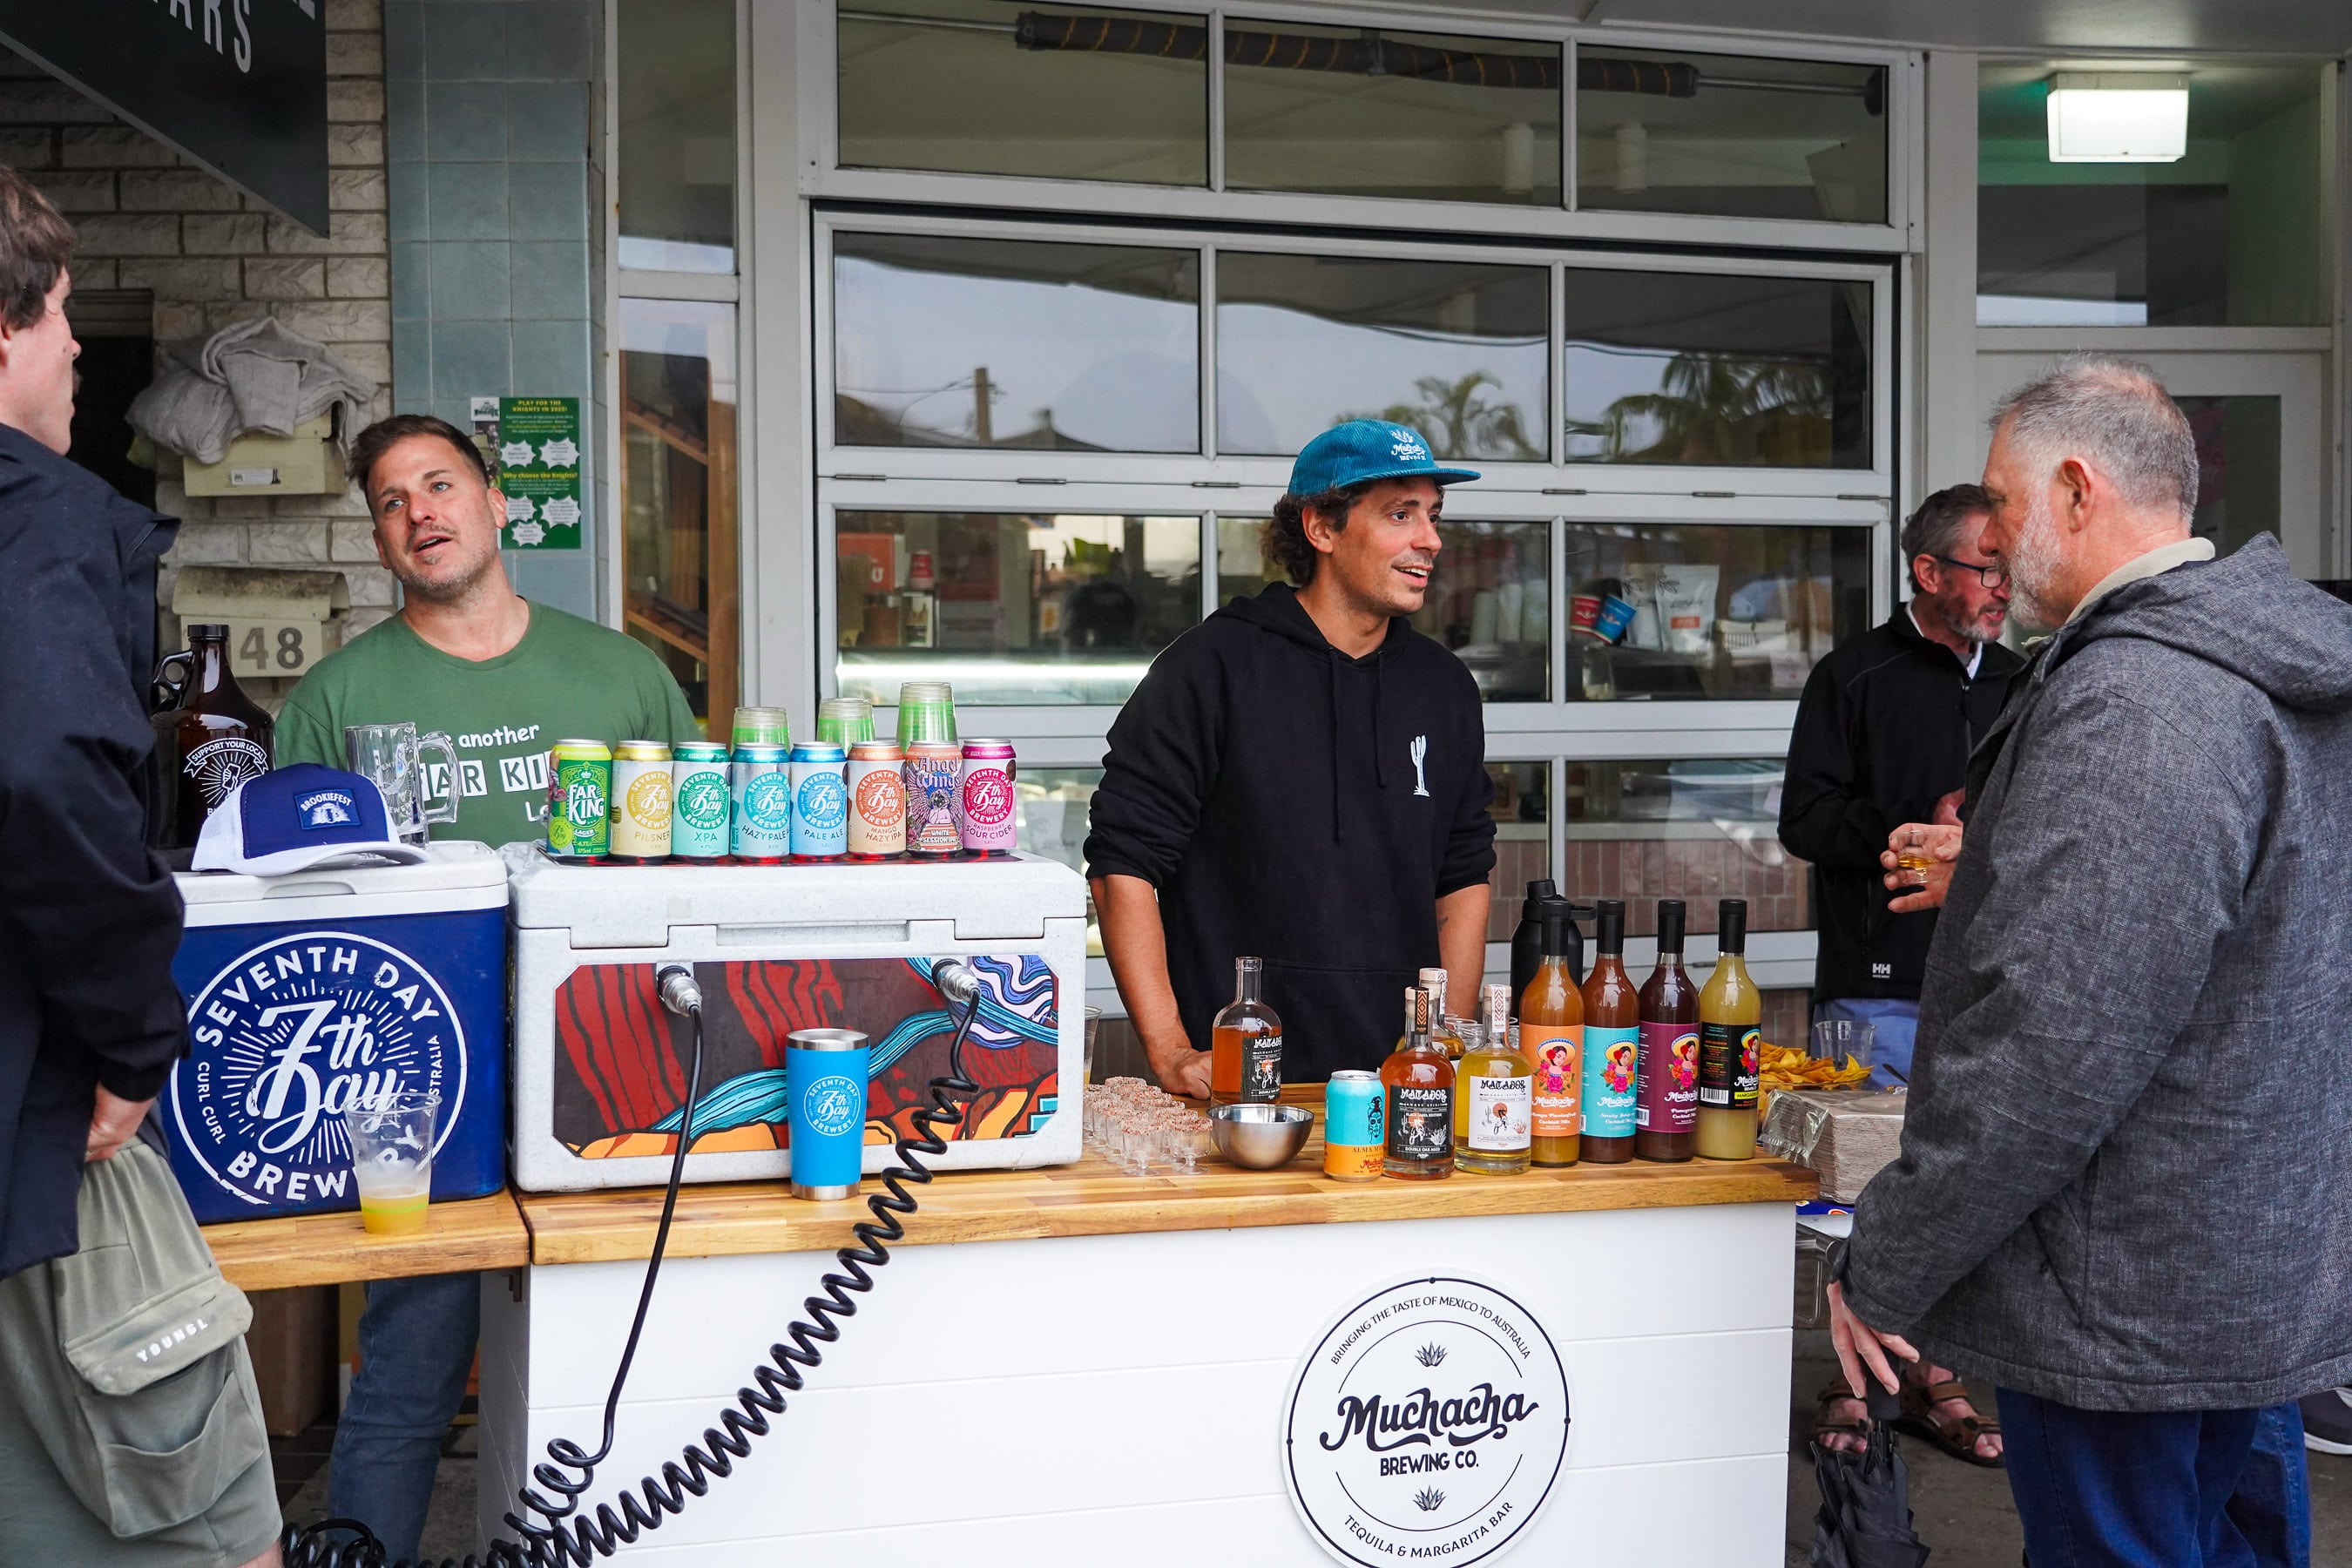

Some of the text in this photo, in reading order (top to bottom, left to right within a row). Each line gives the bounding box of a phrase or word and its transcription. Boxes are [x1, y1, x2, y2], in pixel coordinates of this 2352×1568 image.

[240, 627, 305, 670] 48
[458, 724, 539, 748] another
[192, 740, 264, 762] SUPPORT YOUR LOCAL
[632, 773, 666, 792] SEVENTH
[681, 773, 718, 792] SEVENTH
[748, 774, 782, 793] SEVENTH
[801, 773, 836, 793] SEVENTH
[859, 771, 894, 790] SEVENTH
[966, 770, 1011, 787] SEVENTH DAY
[569, 784, 598, 801] FAR
[645, 784, 666, 803] 7th
[695, 784, 720, 803] 7th
[761, 784, 784, 803] 7th
[814, 784, 836, 803] 7th
[871, 783, 896, 801] 7th
[977, 781, 1002, 800] 7th
[301, 792, 352, 812] BROOKIEFEST
[569, 797, 605, 825] KING
[640, 796, 669, 816] Day
[690, 796, 721, 816] Day
[757, 796, 786, 817] Day
[809, 796, 841, 816] Day
[868, 794, 898, 814] Day
[974, 793, 1004, 812] Day
[685, 813, 725, 828] BREWERY
[752, 813, 787, 828] BREWERY
[805, 813, 843, 828] BREWERY
[863, 810, 902, 825] BREWERY
[970, 808, 1009, 822] BREWERY
[634, 831, 670, 841] PILSNER
[694, 832, 718, 841] XPA
[742, 824, 766, 841] HAZY
[768, 831, 785, 841] PALE
[804, 828, 827, 840] PALE
[830, 828, 843, 840] ALE
[866, 830, 902, 842] HAZY IPA
[965, 824, 1012, 839] SOUR CIDER
[1872, 963, 1891, 974] HH
[195, 946, 440, 1047] SEVENTH DAY
[258, 999, 383, 1099] 7th
[809, 1079, 858, 1097] SEVENTH DAY
[1480, 1080, 1525, 1092] MATADOR
[197, 1061, 227, 1145] CURL CURL
[246, 1058, 403, 1153] Day
[821, 1090, 847, 1109] 7th
[1400, 1089, 1447, 1103] MATADOR
[1531, 1096, 1576, 1108] Muchacha
[817, 1102, 849, 1121] Day
[813, 1119, 852, 1132] BREWERY
[137, 1318, 208, 1362] YOUNGL
[1331, 1296, 1531, 1365] BRINGING THE TASTE OF MEXICO TO AUSTRALIA
[1319, 1382, 1539, 1452] Muchacha
[1380, 1450, 1479, 1477] BREWING CO.
[1344, 1501, 1513, 1558] TEQUILA & MARGARITA BAR
